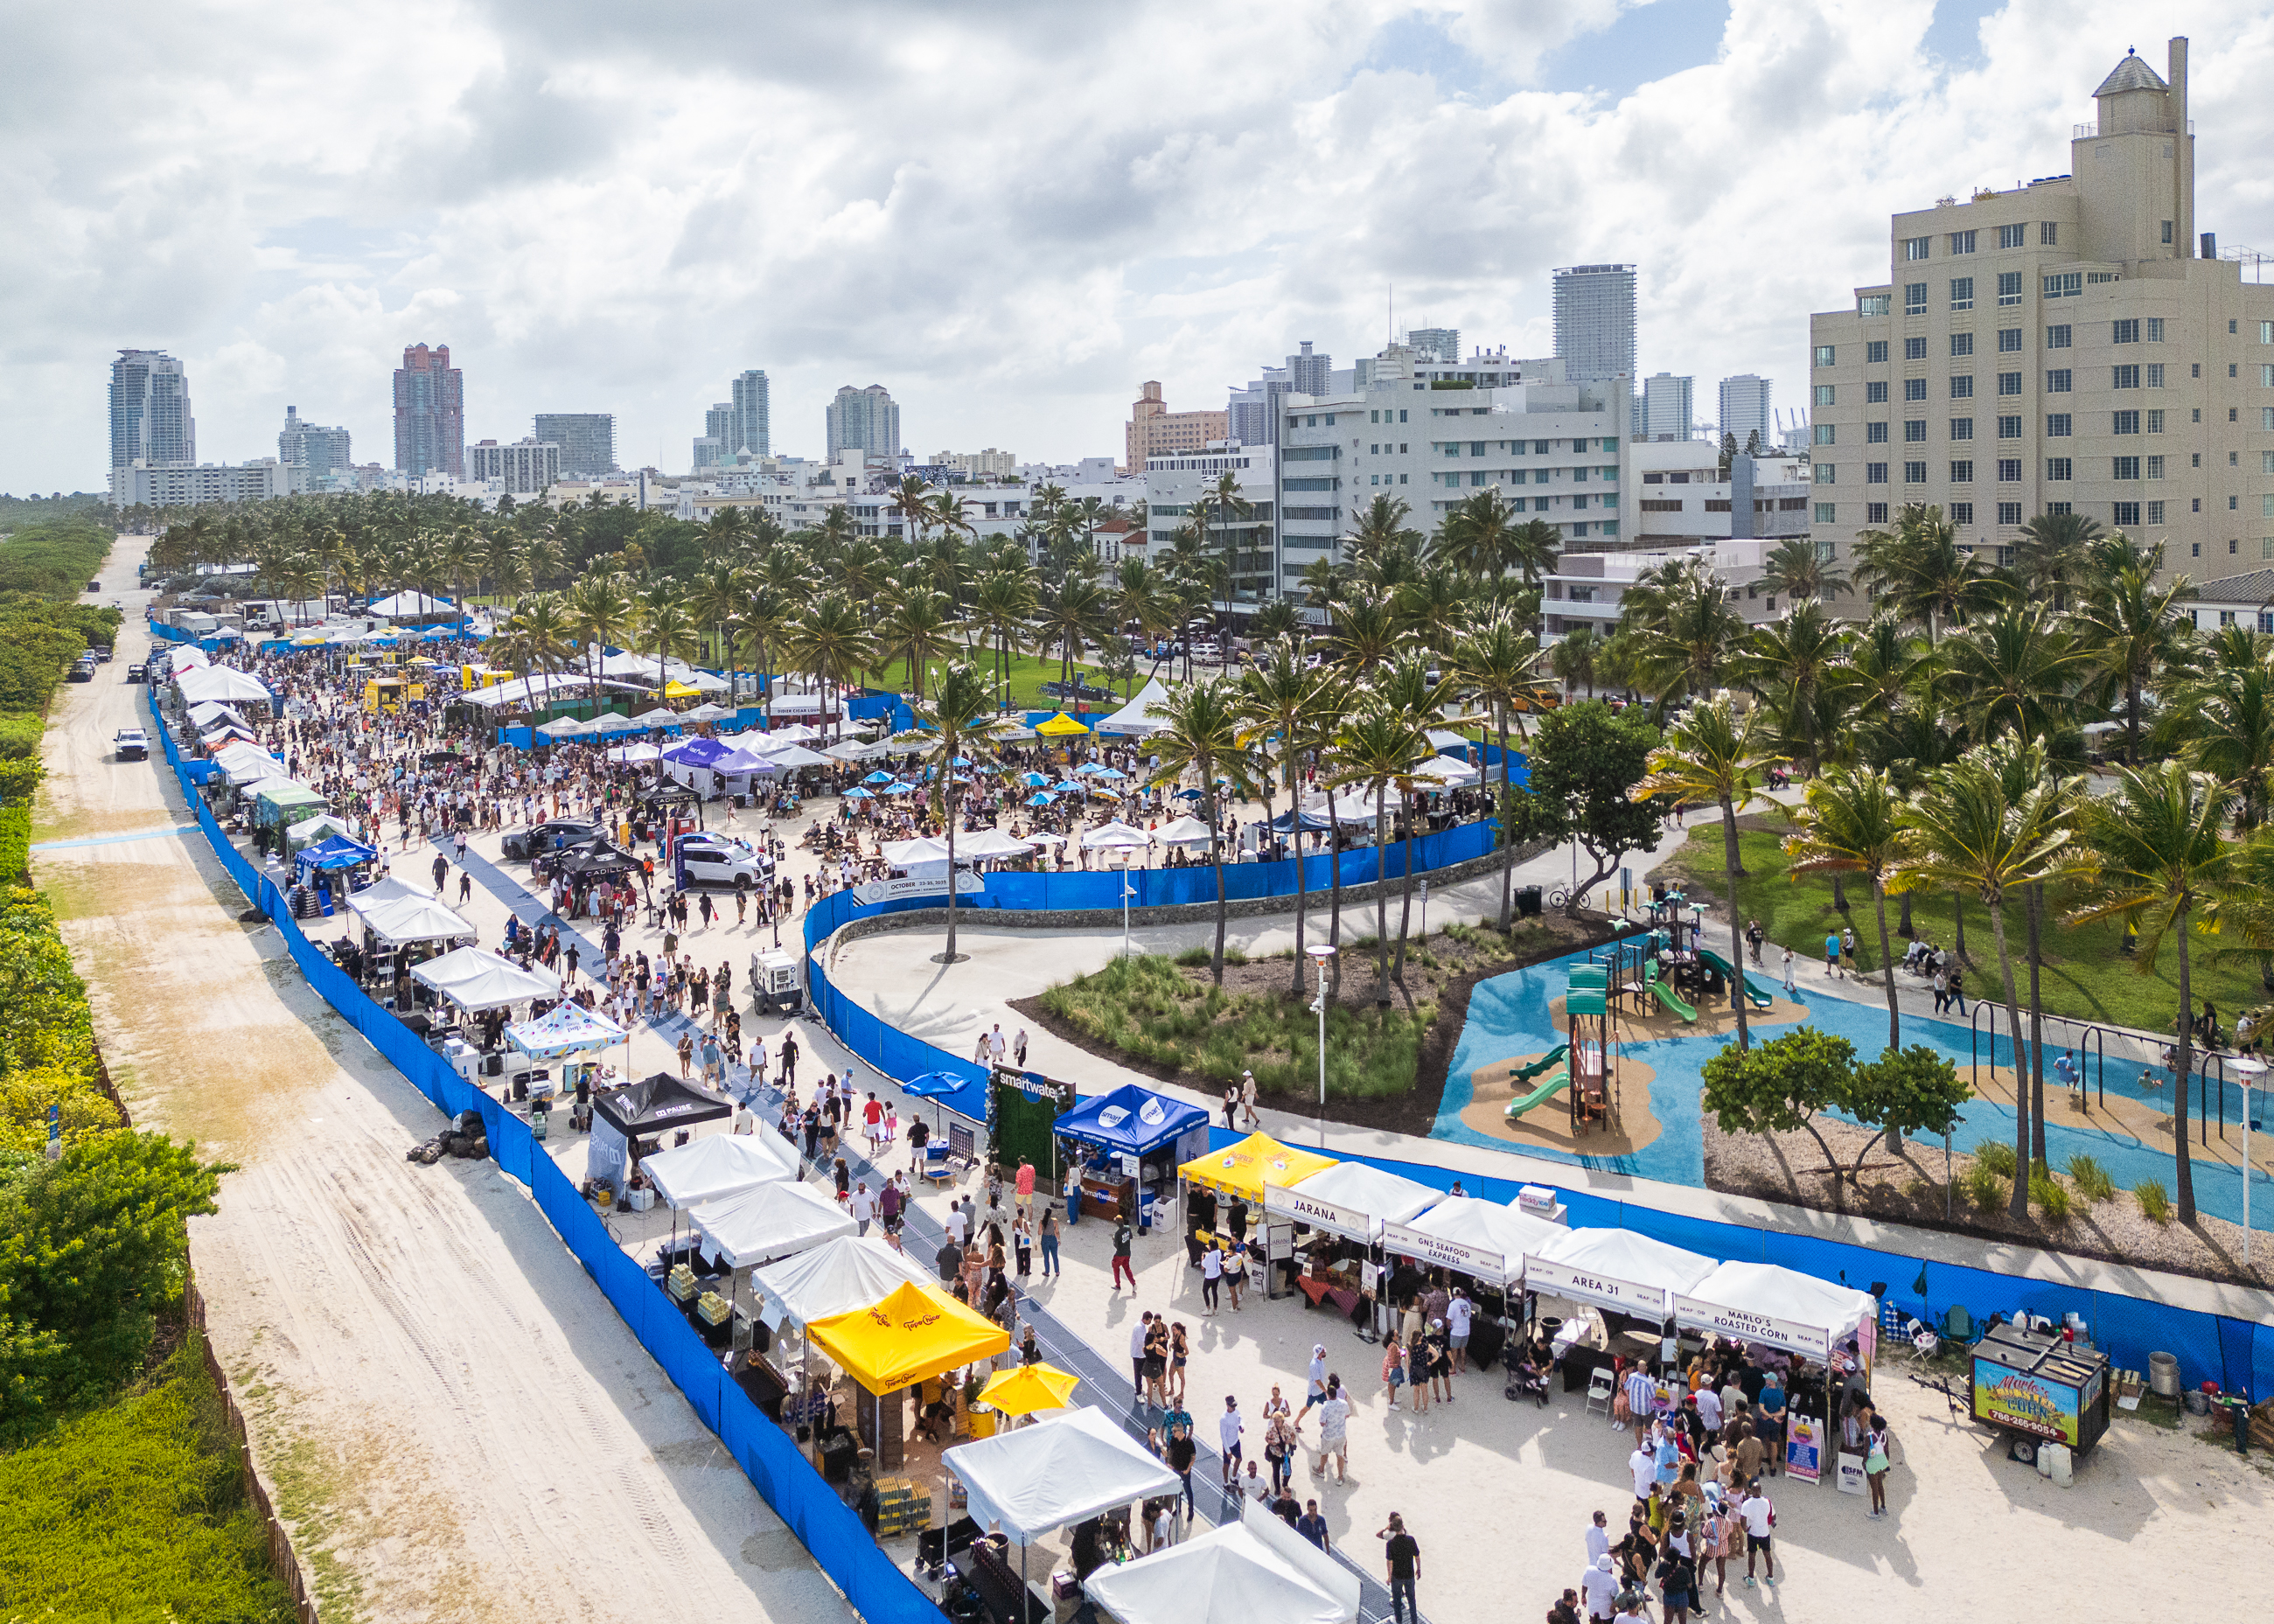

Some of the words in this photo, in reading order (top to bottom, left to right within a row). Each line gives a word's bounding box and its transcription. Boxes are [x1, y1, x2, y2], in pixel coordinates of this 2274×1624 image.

[652, 795, 695, 805] CADILLAC
[585, 864, 637, 877] CADILLAC
[890, 882, 916, 890] OCTOBER
[666, 1103, 694, 1114] PAUSE
[1142, 1105, 1161, 1121] smart
[1100, 1111, 1122, 1122] smart
[1054, 1125, 1079, 1136] smartwater
[1162, 1126, 1183, 1140] smartwater
[1083, 1133, 1107, 1144] smartwater
[1140, 1138, 1161, 1153] smartwater
[1111, 1140, 1136, 1153] smartwater
[1084, 1189, 1119, 1203] smartwater
[1294, 1200, 1336, 1223] JARANA
[1418, 1237, 1433, 1248] GNS
[1436, 1242, 1470, 1258] SEAFOOD
[1428, 1249, 1461, 1265] EXPRESS
[1572, 1275, 1603, 1292] AREA
[1607, 1284, 1619, 1296] 31
[903, 1319, 922, 1332] Topo
[922, 1314, 941, 1326] Chico
[1727, 1310, 1771, 1328] MARLO'S
[1713, 1316, 1758, 1334] ROASTED
[1760, 1328, 1789, 1342] CORN
[884, 1377, 901, 1390] Topo
[900, 1372, 917, 1384] Chico
[1996, 1375, 2049, 1399] Marlo's
[2007, 1398, 2047, 1419] CORN
